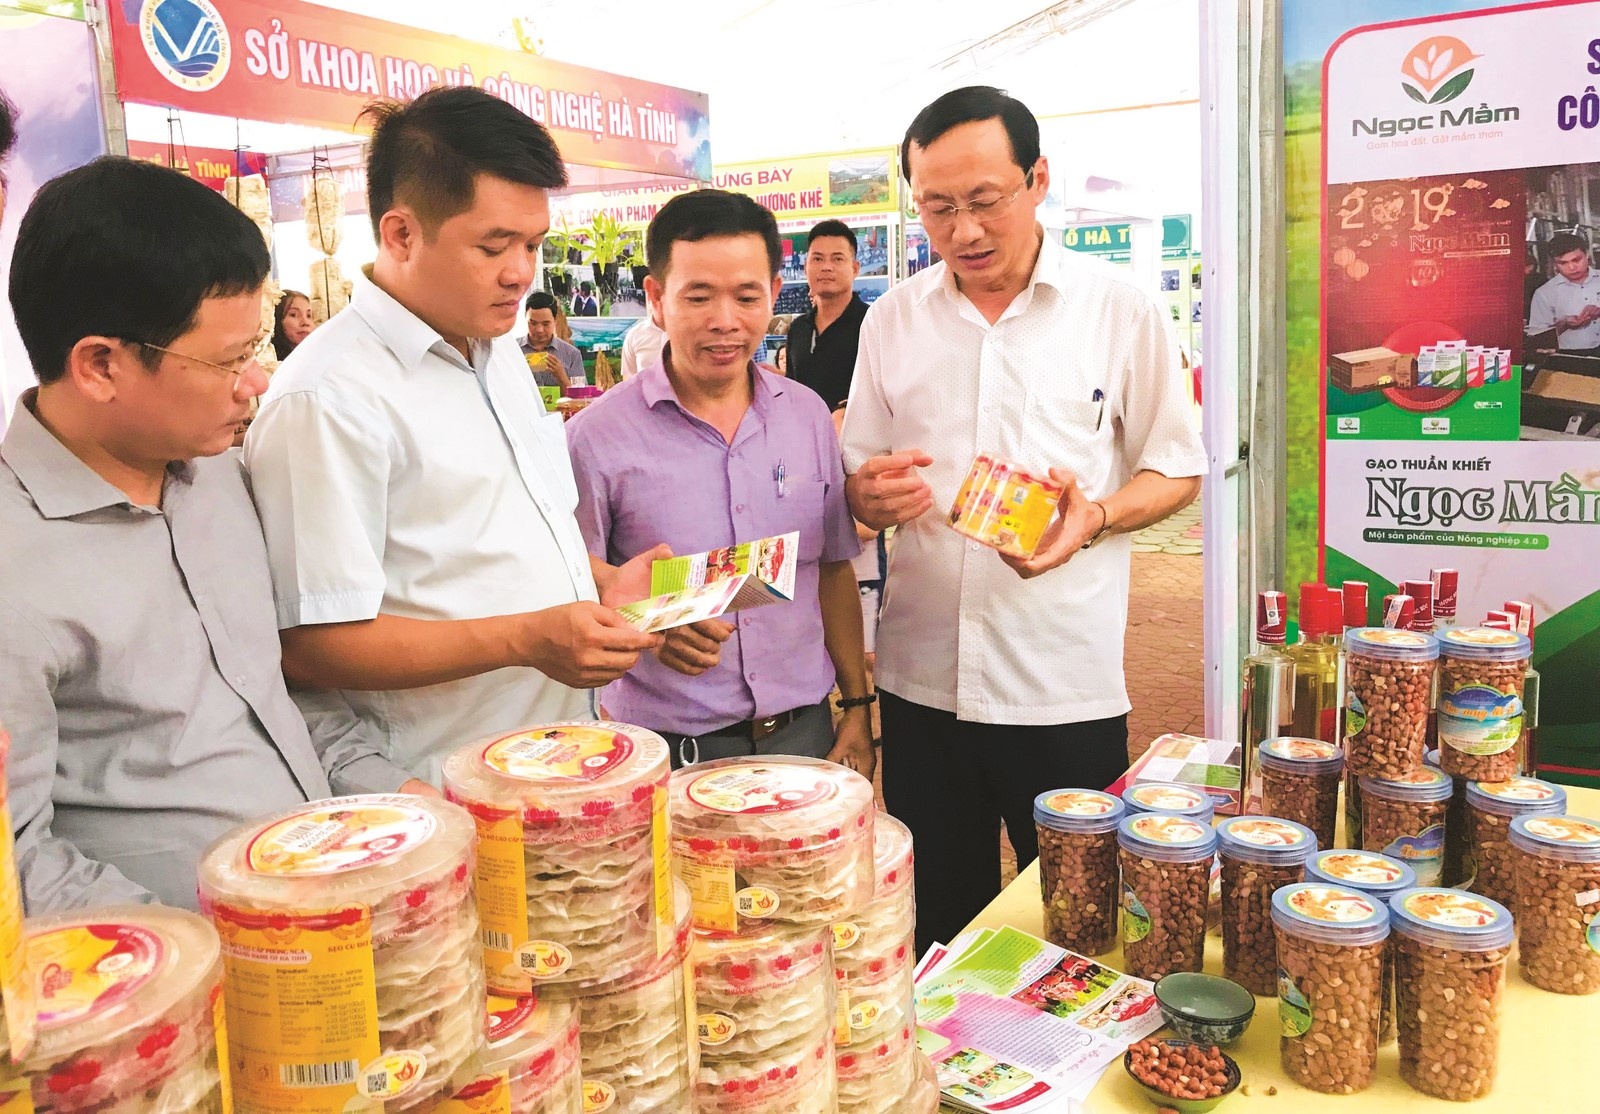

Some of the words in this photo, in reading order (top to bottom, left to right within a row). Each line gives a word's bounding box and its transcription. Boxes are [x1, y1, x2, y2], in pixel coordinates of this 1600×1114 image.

[245, 19, 289, 80] SỞ
[298, 40, 379, 95] KHOA
[550, 91, 604, 143] NGHỆ
[608, 97, 634, 138] HÀ
[637, 104, 677, 145] TĨNH
[1352, 117, 1434, 138] Ngọc
[1440, 103, 1519, 128] Mầm
[1367, 140, 1389, 150] Gom
[195, 158, 231, 178] TĨNH
[757, 166, 794, 185] BÀY
[800, 186, 823, 209] KHÊ
[1084, 226, 1112, 245] HÀ
[1365, 459, 1398, 472] GẠO
[1452, 456, 1491, 471] KHIẾT
[1365, 477, 1494, 527] Ngọc
[1368, 531, 1385, 541] Một
[1388, 532, 1404, 540] sản
[1436, 533, 1454, 542] của
[1457, 534, 1482, 544] Nông
[1523, 537, 1539, 545] 4.0
